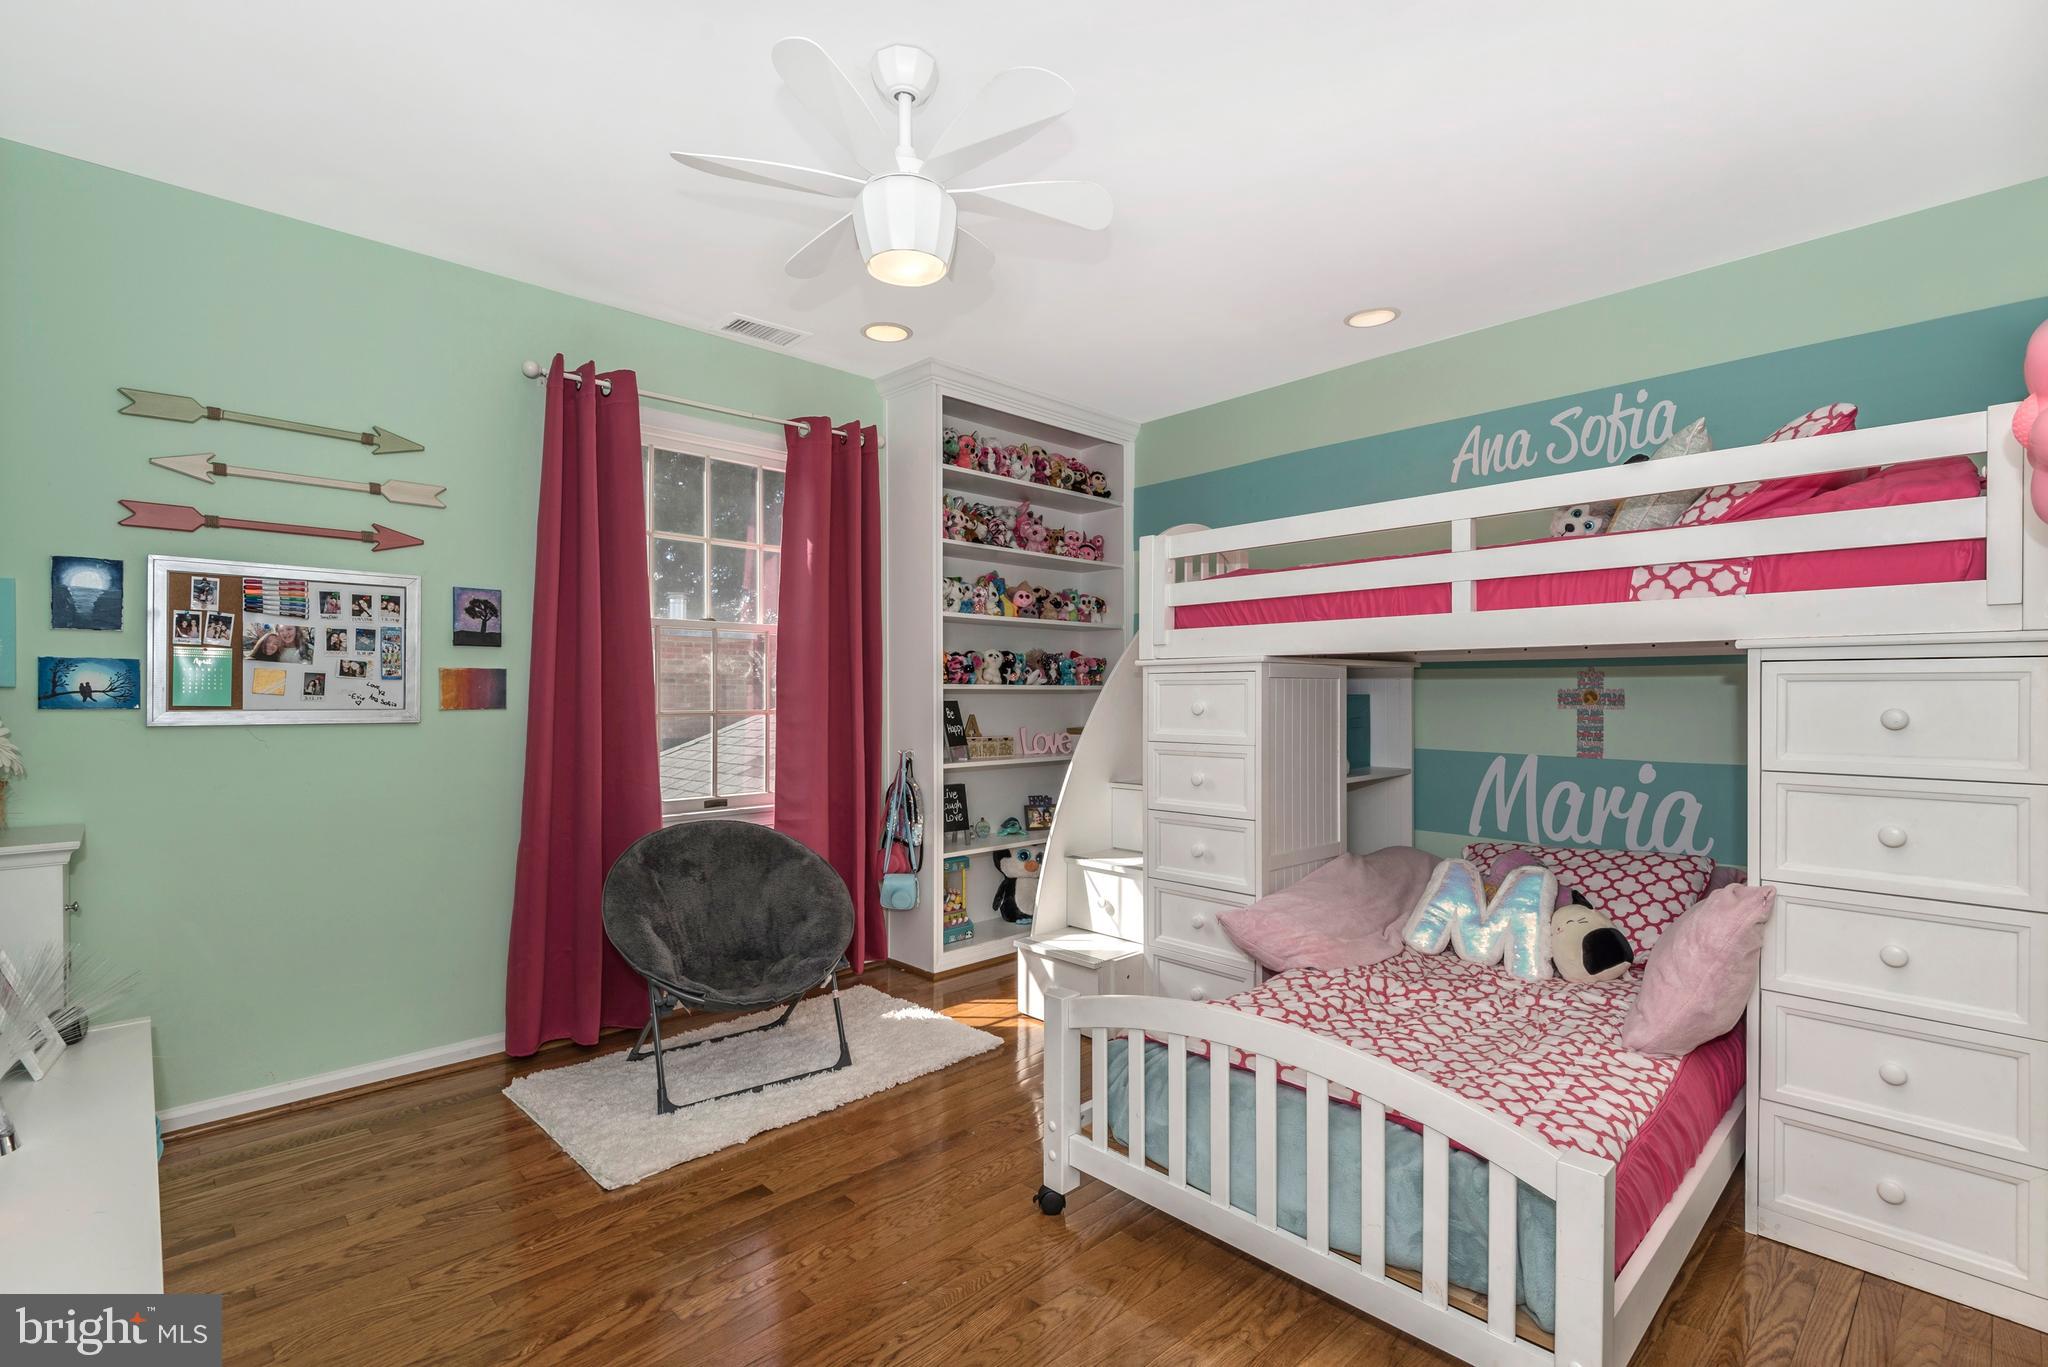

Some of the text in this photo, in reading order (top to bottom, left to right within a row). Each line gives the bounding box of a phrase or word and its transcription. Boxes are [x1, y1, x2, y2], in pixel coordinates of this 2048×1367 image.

[1450, 388, 1677, 484] Ana Sofia
[193, 657, 212, 667] April
[945, 707, 955, 719] Be
[946, 723, 963, 737] Happy
[1019, 727, 1073, 755] Love
[1468, 754, 1715, 857] Maria
[945, 812, 964, 823] Love
